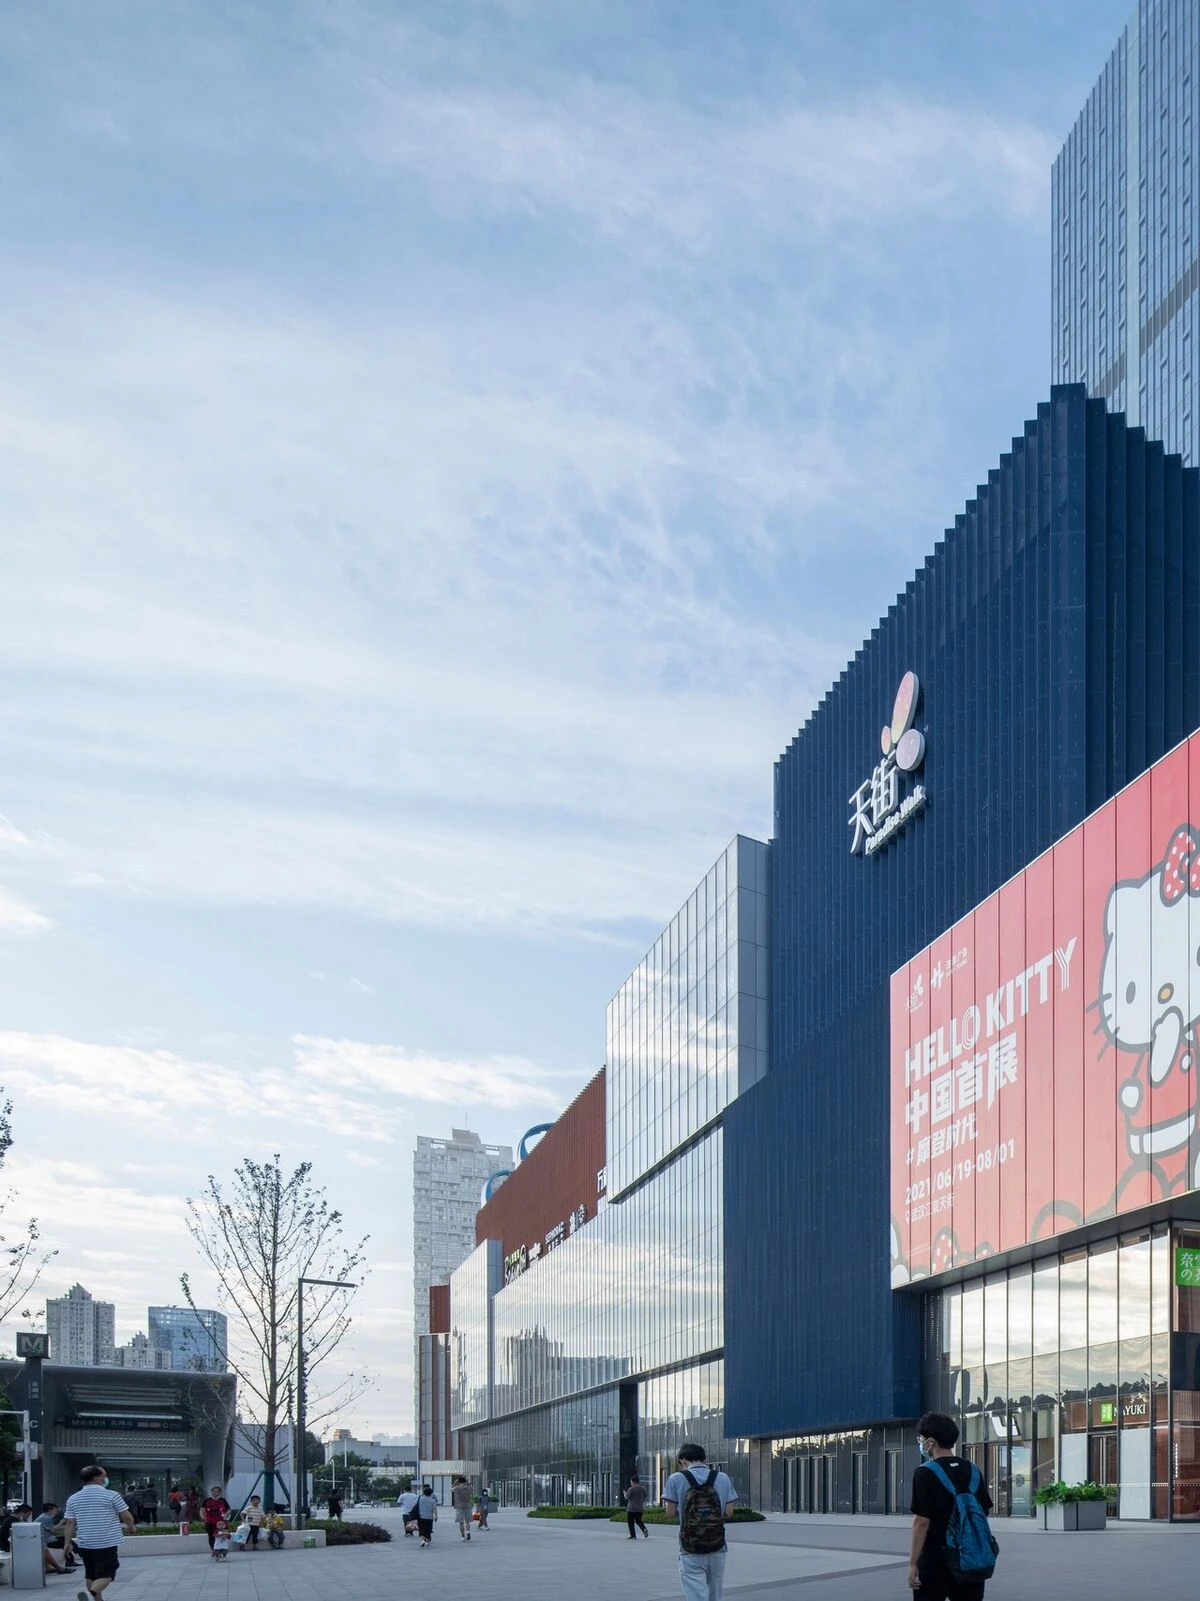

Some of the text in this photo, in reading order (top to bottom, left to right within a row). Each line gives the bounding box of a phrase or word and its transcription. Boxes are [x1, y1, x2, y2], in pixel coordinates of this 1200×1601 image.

[848, 748, 898, 854] 天街
[905, 936, 1078, 1088] HELLO KITTY
[905, 1032, 1018, 1135] 中国首展
[905, 1138, 1015, 1205] 2021/06/19-08/01
